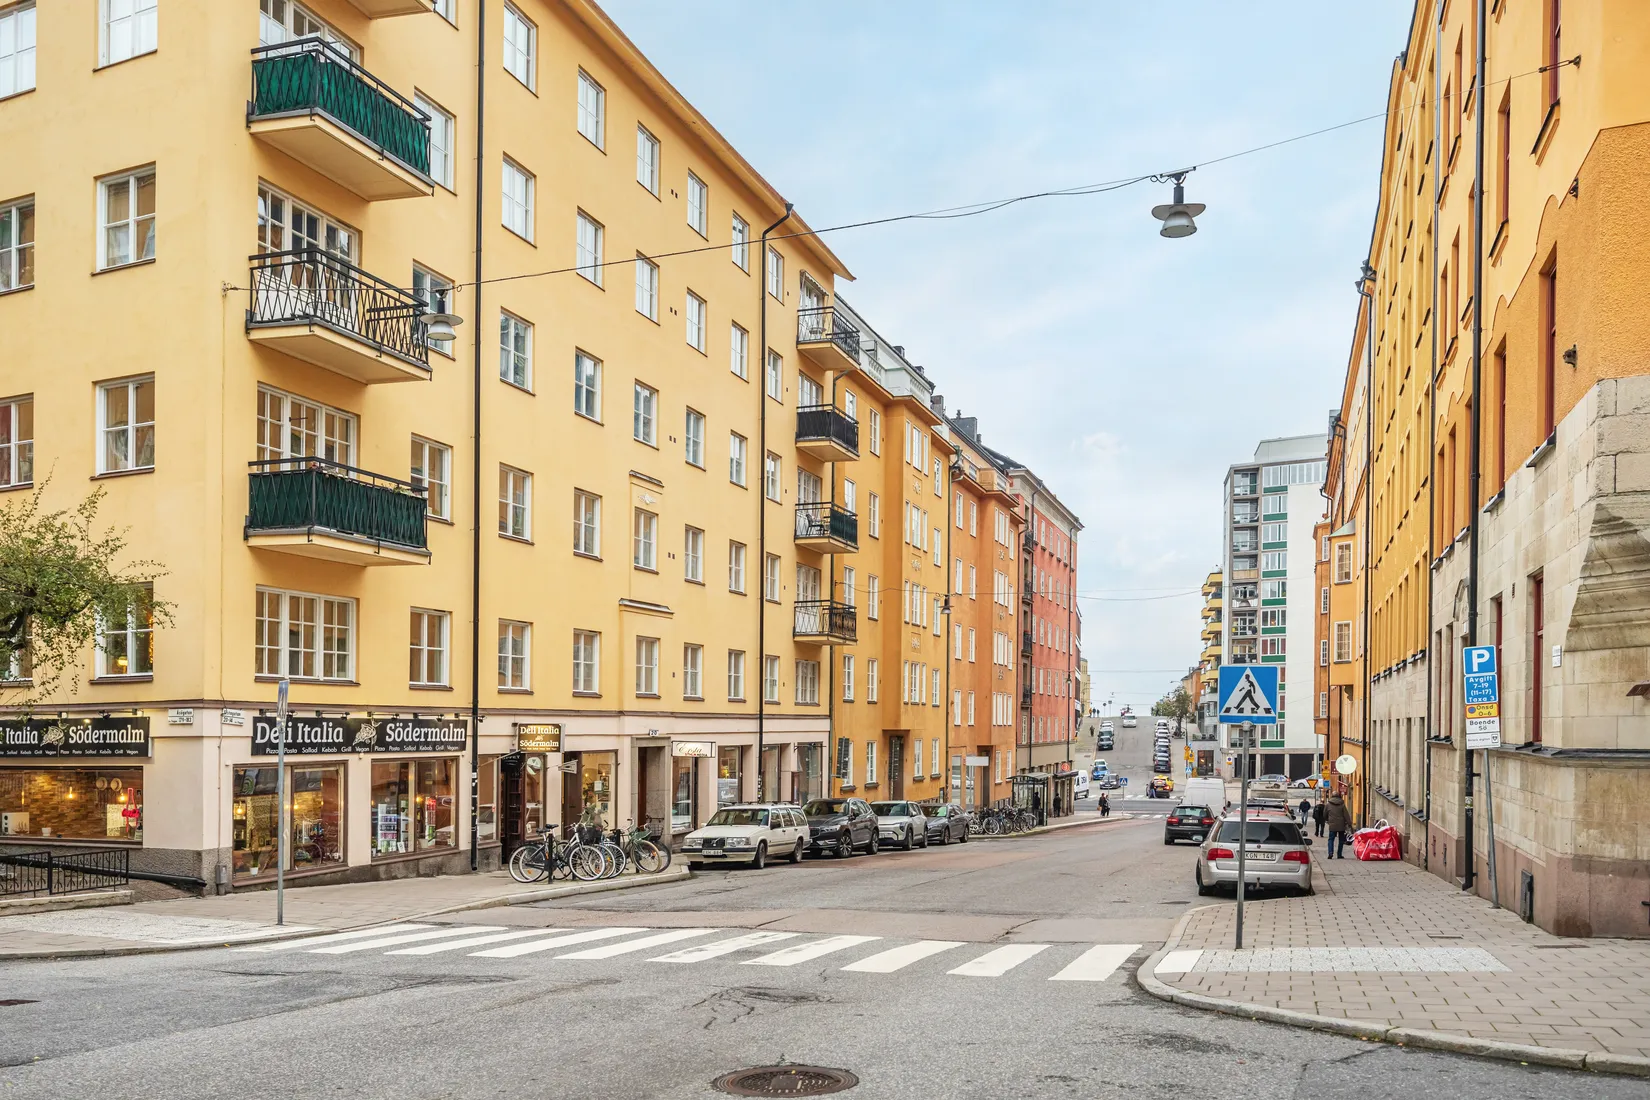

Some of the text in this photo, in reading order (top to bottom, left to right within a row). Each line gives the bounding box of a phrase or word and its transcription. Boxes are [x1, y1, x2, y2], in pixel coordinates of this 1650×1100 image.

[1472, 650, 1490, 672] P
[5, 726, 38, 744] Italia
[68, 724, 144, 744] Södermalm
[255, 722, 466, 744] Dei Italia Södermalm
[520, 725, 560, 734] Deli Italia
[520, 740, 559, 748] Södermalm
